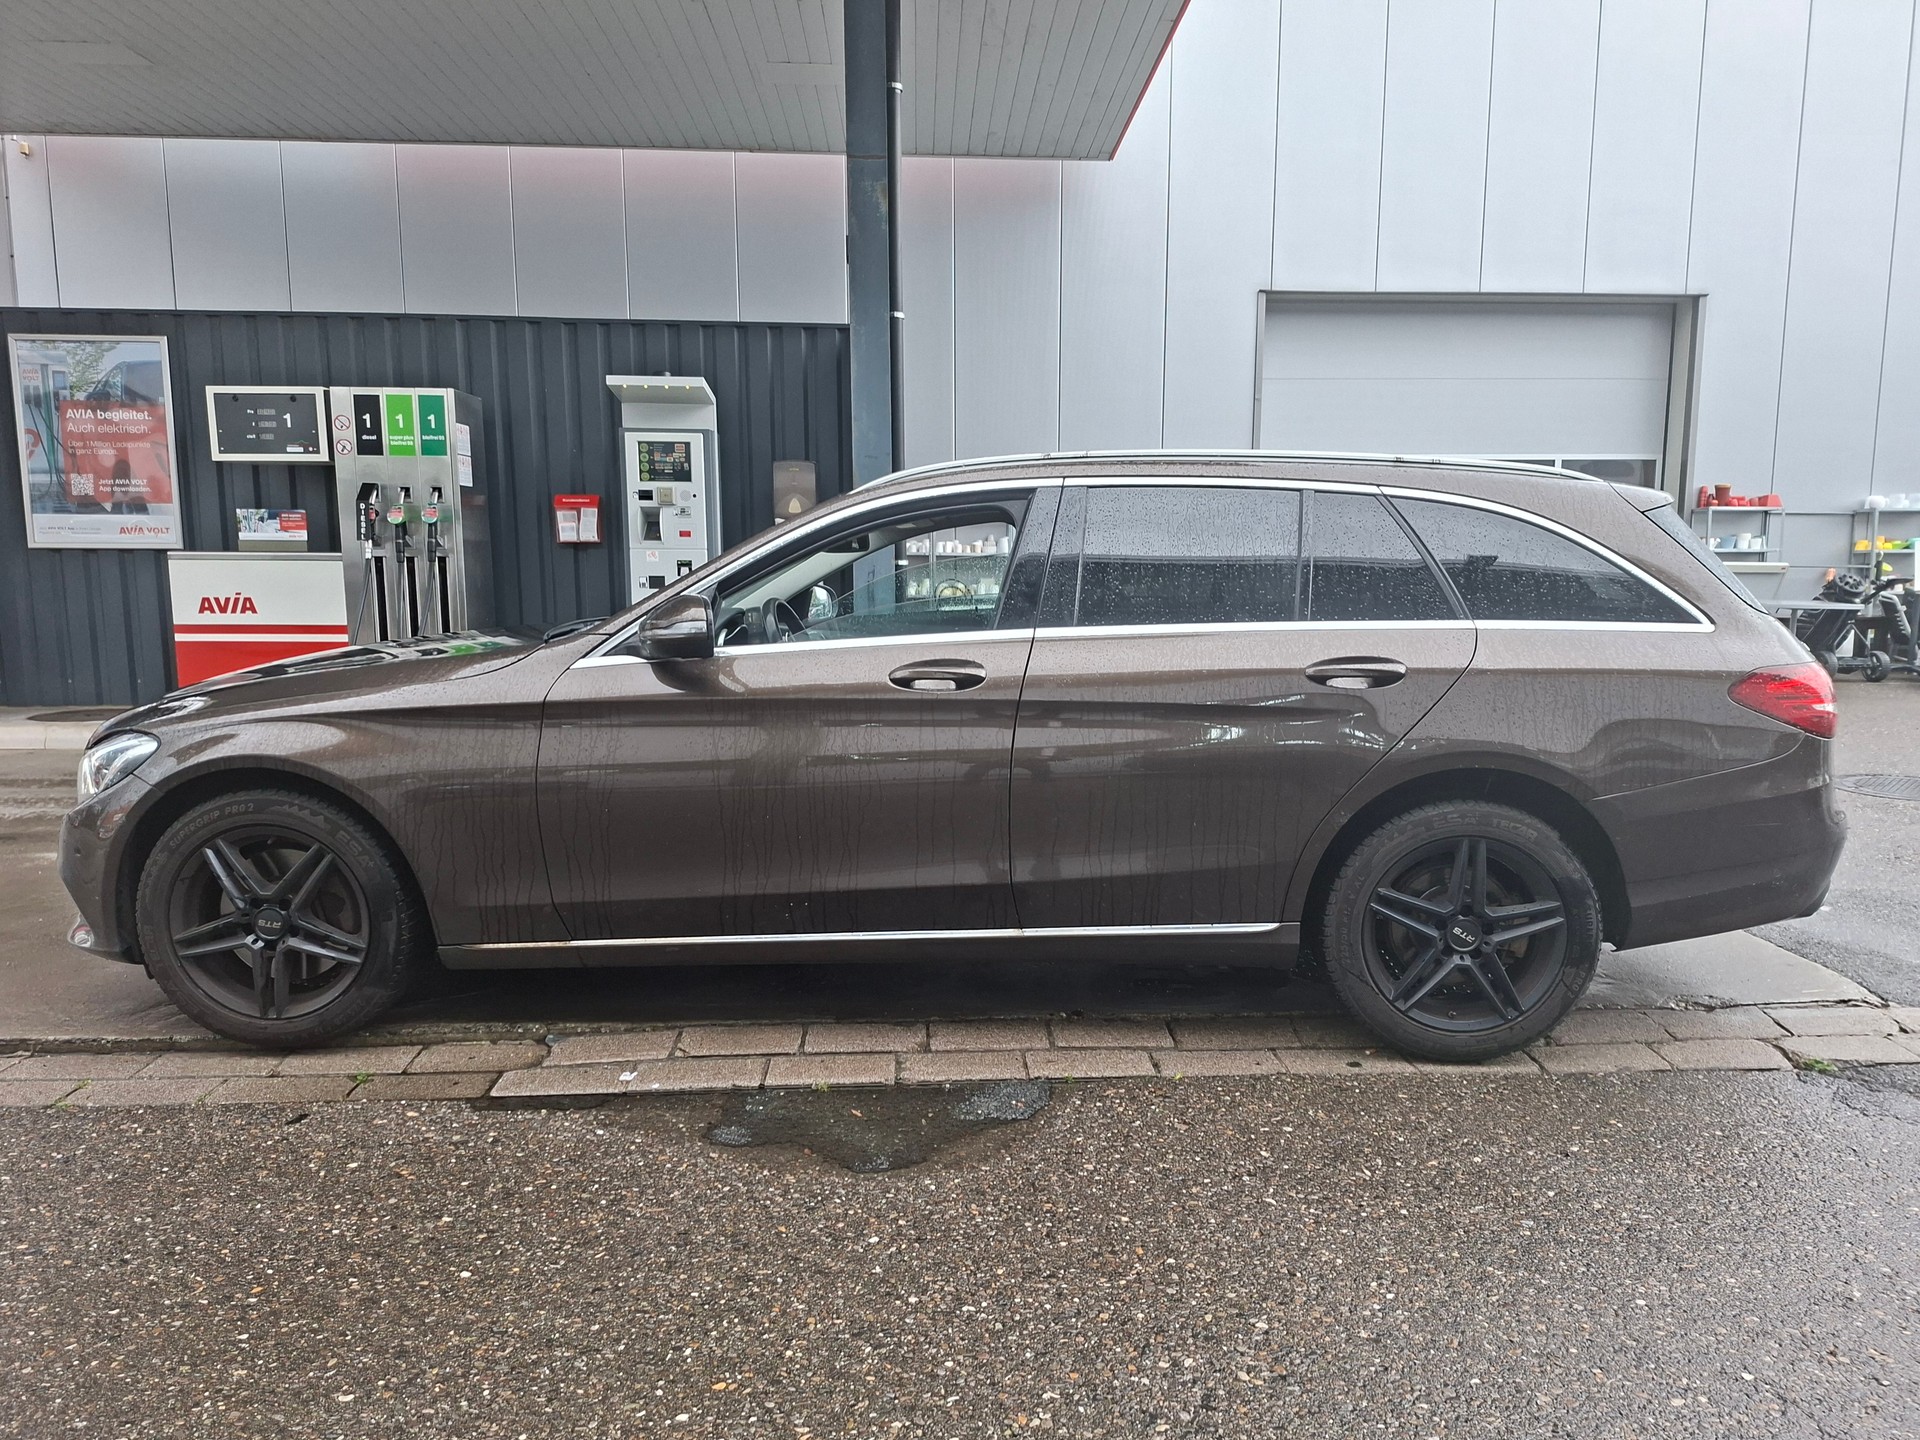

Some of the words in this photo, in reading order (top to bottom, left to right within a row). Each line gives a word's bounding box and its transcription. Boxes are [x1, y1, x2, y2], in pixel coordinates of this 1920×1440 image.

[66, 408, 95, 419] AVIA
[97, 409, 152, 422] begleitet.
[283, 412, 291, 428] 1
[362, 413, 371, 429] 1
[395, 413, 404, 429] 1
[427, 413, 436, 429] 1
[67, 422, 95, 433] Auch
[97, 423, 151, 434] elektrisch.
[146, 527, 170, 538] VOLT
[169, 810, 221, 849] SUPERGRIP
[258, 919, 281, 929] RTS
[1452, 926, 1476, 943] RTS
